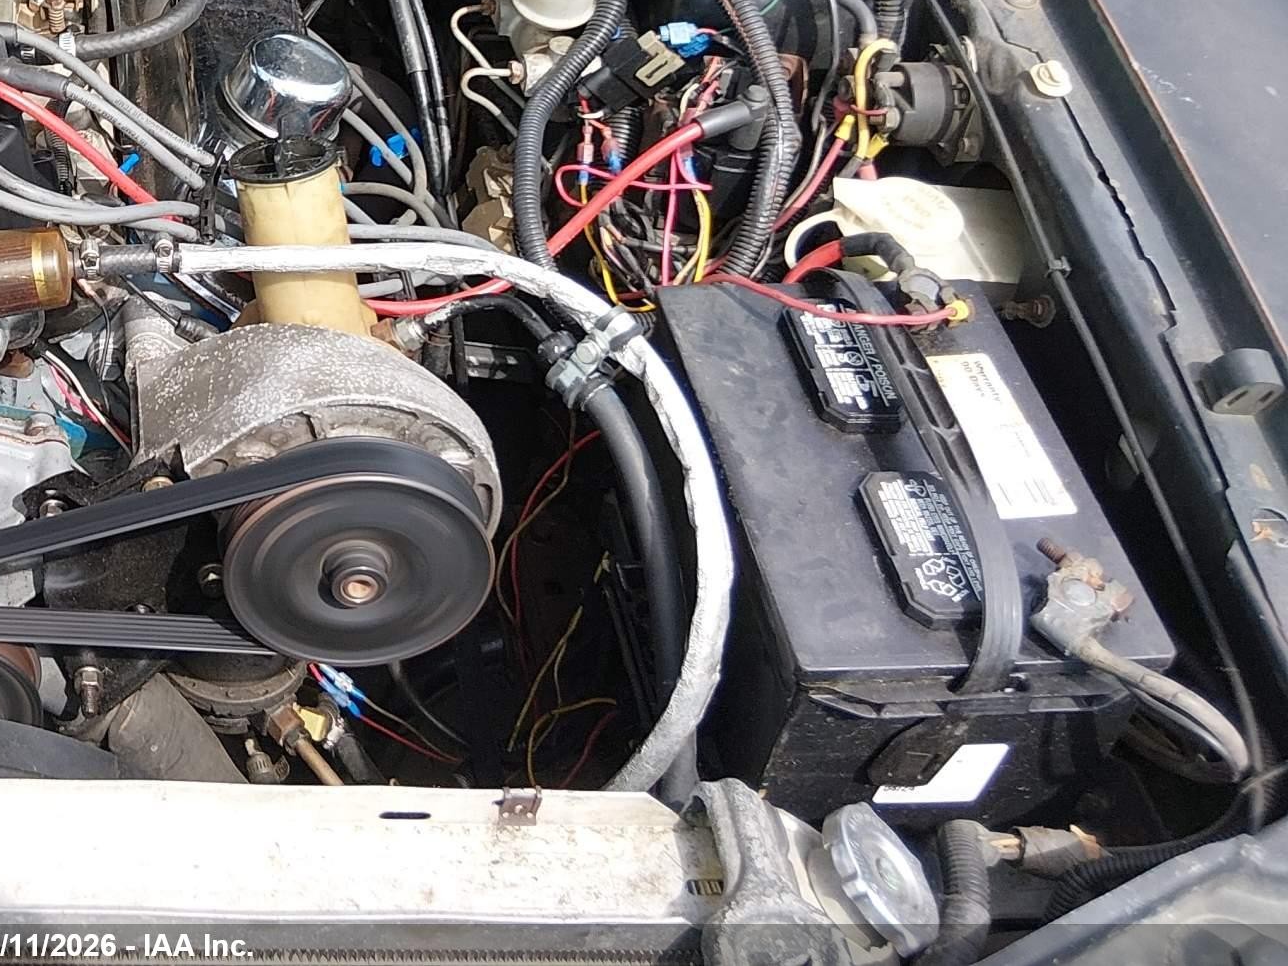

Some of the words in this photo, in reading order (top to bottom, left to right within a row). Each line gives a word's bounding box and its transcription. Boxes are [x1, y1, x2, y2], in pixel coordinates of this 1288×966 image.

[852, 322, 877, 355] ANGER
[871, 362, 898, 400] POISON
[974, 360, 1001, 402] Warranty
